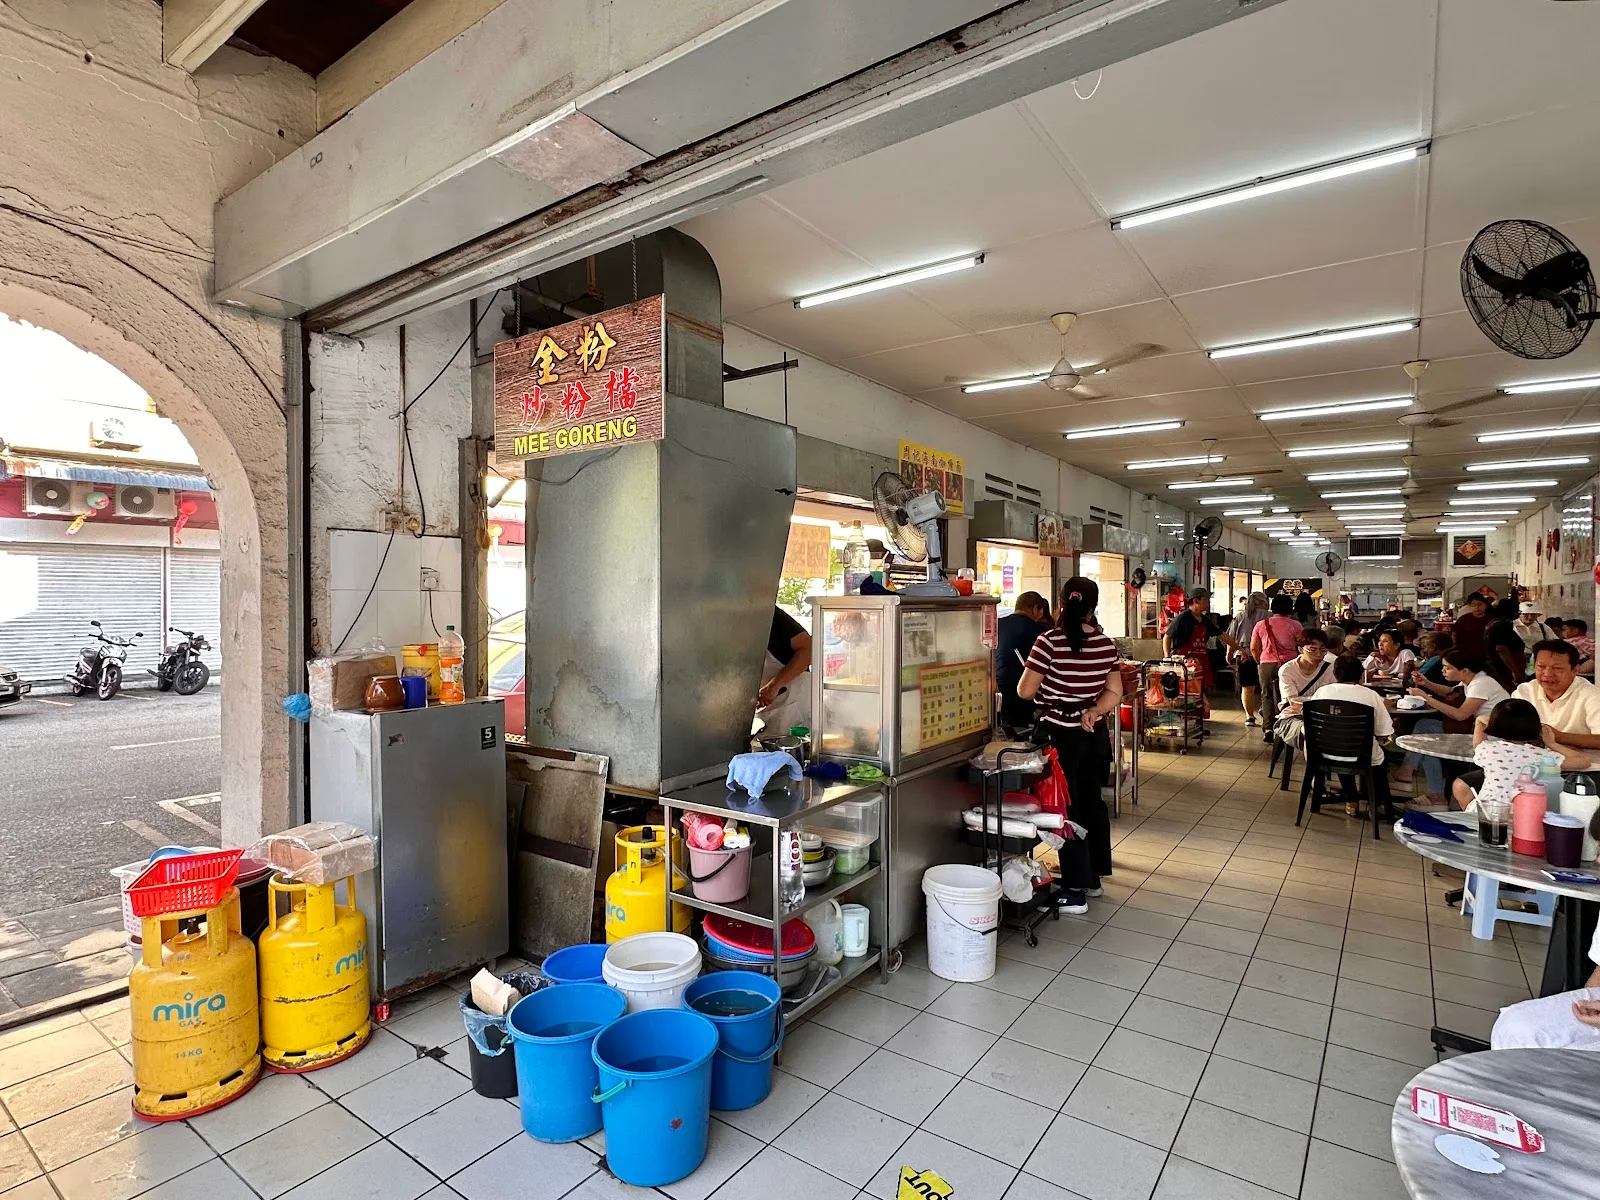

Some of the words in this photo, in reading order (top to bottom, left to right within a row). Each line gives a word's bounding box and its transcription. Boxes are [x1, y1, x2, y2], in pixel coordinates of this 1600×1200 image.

[531, 321, 617, 386] 金粉
[519, 365, 641, 432] 炒粉檔
[514, 432, 550, 456] MEE
[554, 416, 637, 449] GORENG
[484, 727, 493, 739] 5
[335, 939, 368, 975] mir
[153, 991, 226, 1022] mira
